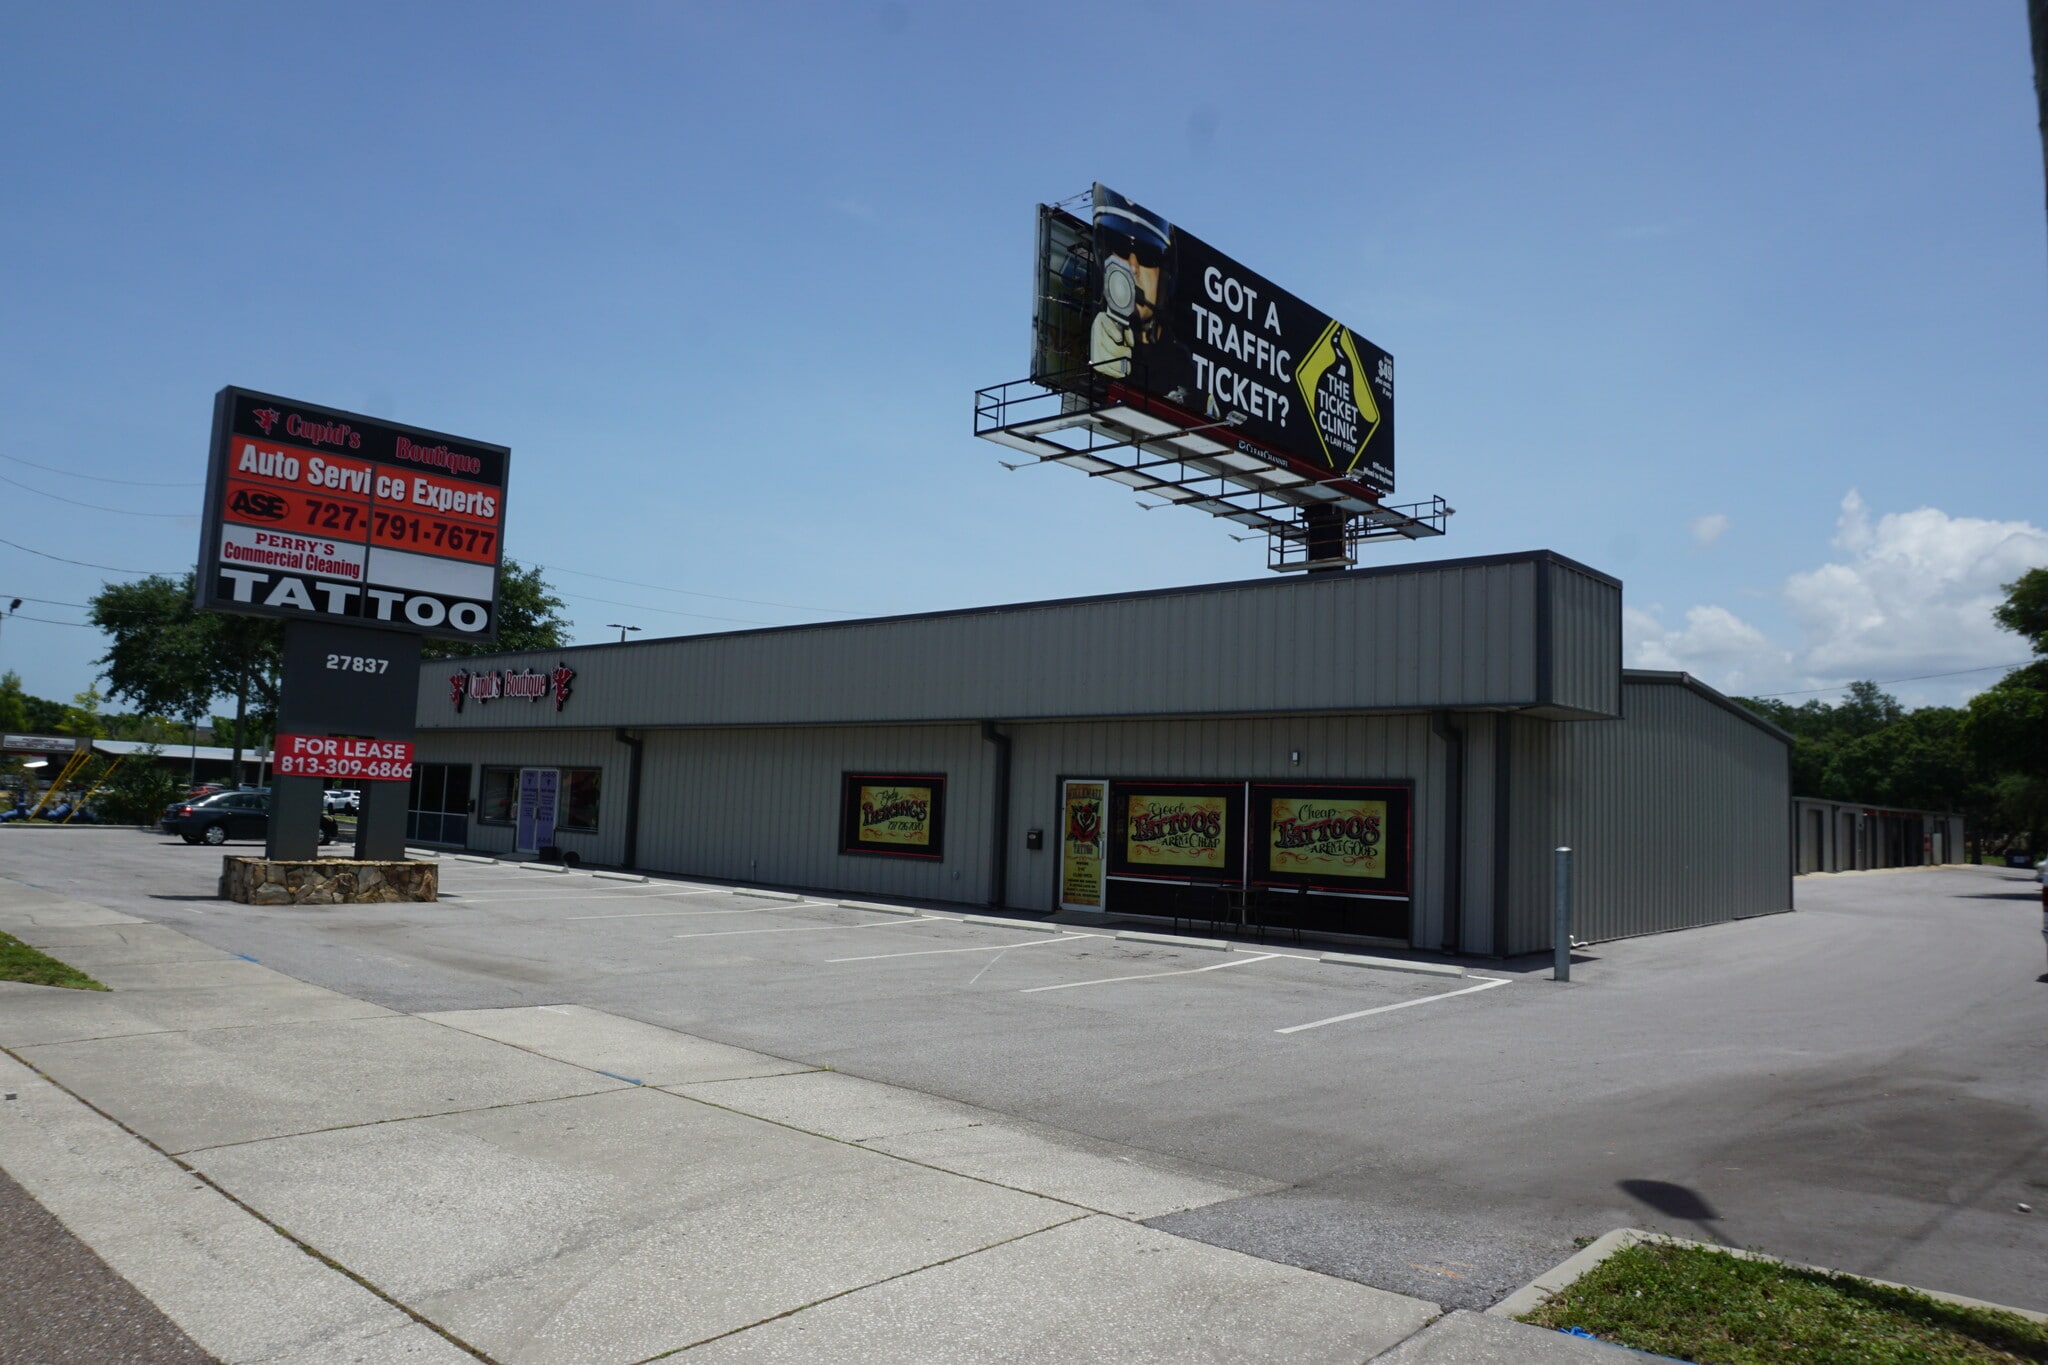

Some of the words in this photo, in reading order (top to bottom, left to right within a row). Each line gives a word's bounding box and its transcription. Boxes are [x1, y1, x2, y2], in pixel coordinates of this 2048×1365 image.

[1204, 266, 1257, 320] GOT
[1264, 301, 1281, 336] A
[1191, 302, 1291, 383] TRAFFIC
[1192, 353, 1290, 428] TICKET?
[1326, 373, 1350, 401] THE
[1318, 388, 1358, 424] TICKET
[1318, 410, 1358, 444] CLINIC
[286, 413, 361, 449] Cupid's
[395, 436, 481, 475] Boutique
[1324, 433, 1330, 443] A
[1329, 435, 1343, 449] LAW
[1342, 441, 1356, 456] FIRM
[238, 444, 300, 481] Auto
[307, 457, 405, 500] Service
[412, 477, 496, 518] Experts
[231, 491, 286, 519] ASE
[224, 541, 303, 569] Commercial
[305, 552, 360, 579] Cleaning
[255, 532, 335, 555] PERRY'S
[220, 567, 488, 633] TATTOO
[326, 654, 389, 675] 27837
[468, 671, 501, 703] Cupid's
[503, 668, 547, 702] Boutique
[293, 737, 338, 756] FOR
[344, 741, 406, 760] LEASE
[281, 756, 413, 778] 813-309-6866
[1130, 810, 1222, 841] TATTOOS
[1298, 804, 1338, 822] Cheap
[1273, 815, 1381, 848] TATTOOS
